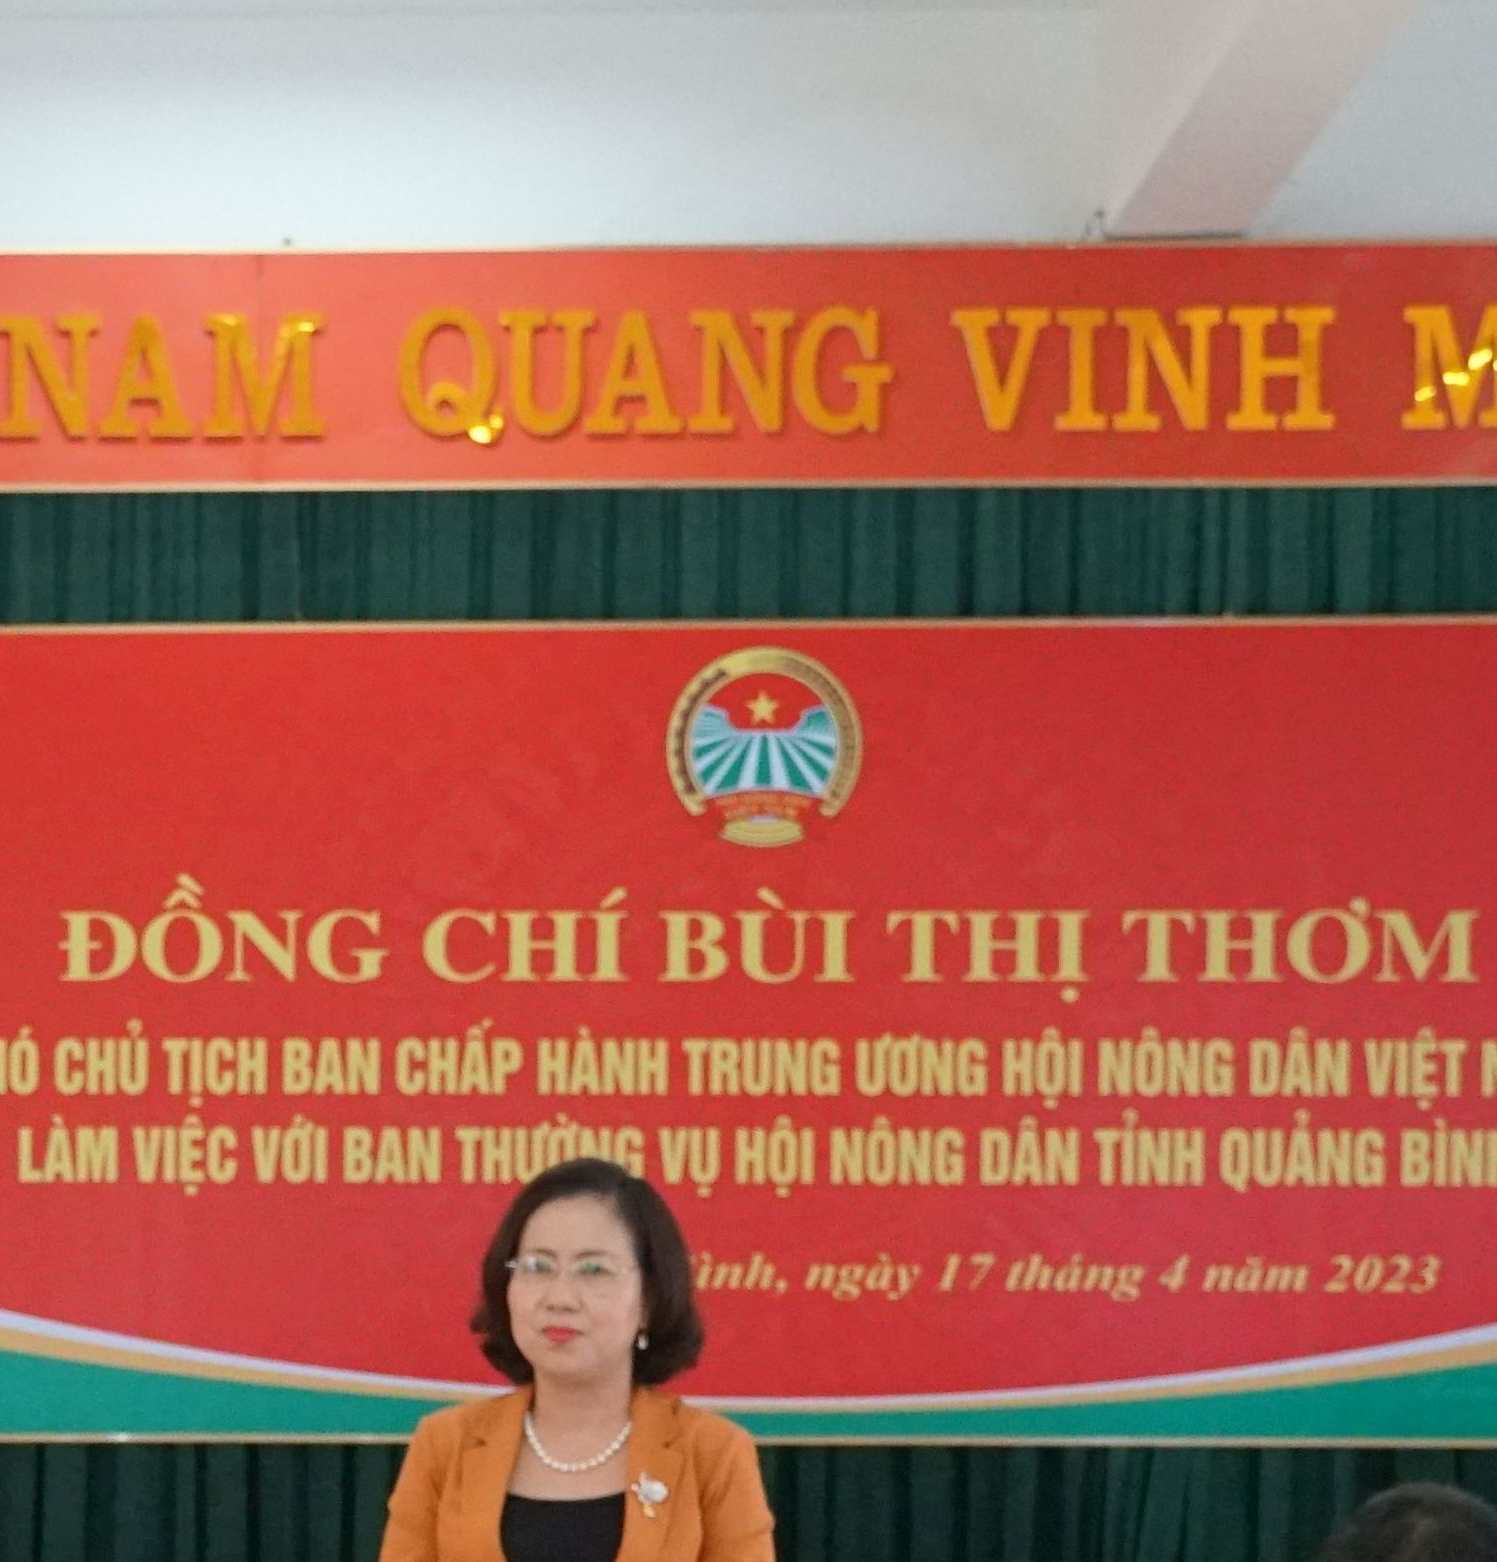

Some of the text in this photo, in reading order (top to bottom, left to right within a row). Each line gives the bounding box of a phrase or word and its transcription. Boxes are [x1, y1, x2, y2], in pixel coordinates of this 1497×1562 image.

[395, 305, 895, 443] QUANG
[949, 305, 1337, 433] VINH
[59, 871, 1478, 1003] ĐỒNG CHÍ BÙI THỊ THƠM
[52, 1017, 151, 1097] CHỦ
[160, 1035, 270, 1109] TỊCH
[280, 1035, 383, 1097] BAN
[393, 1014, 525, 1097] CHẤP
[535, 1025, 671, 1097] HÀNH
[680, 1036, 843, 1098] TRUNG
[854, 1031, 990, 1098] ƯƠNG
[1001, 1026, 1085, 1110] HỘI
[1097, 1026, 1237, 1097] NÔNG
[1249, 1026, 1352, 1098] DÂN
[1363, 1028, 1469, 1109] VIỆT
[16, 1112, 121, 1185] LÀM
[130, 1112, 239, 1197] VIỆC
[251, 1113, 330, 1185] VỚI
[341, 1124, 444, 1185] BAN
[656, 1125, 722, 1198] VỤ
[733, 1114, 817, 1199] HỘI
[828, 1114, 967, 1187] NÔNG
[978, 1115, 1081, 1186] DÂN
[1093, 1106, 1207, 1186] TỈNH
[1220, 1108, 1387, 1191] QUẢNG
[689, 1251, 1442, 1302] ình, ngày 17 tháng 4 năm 2023
